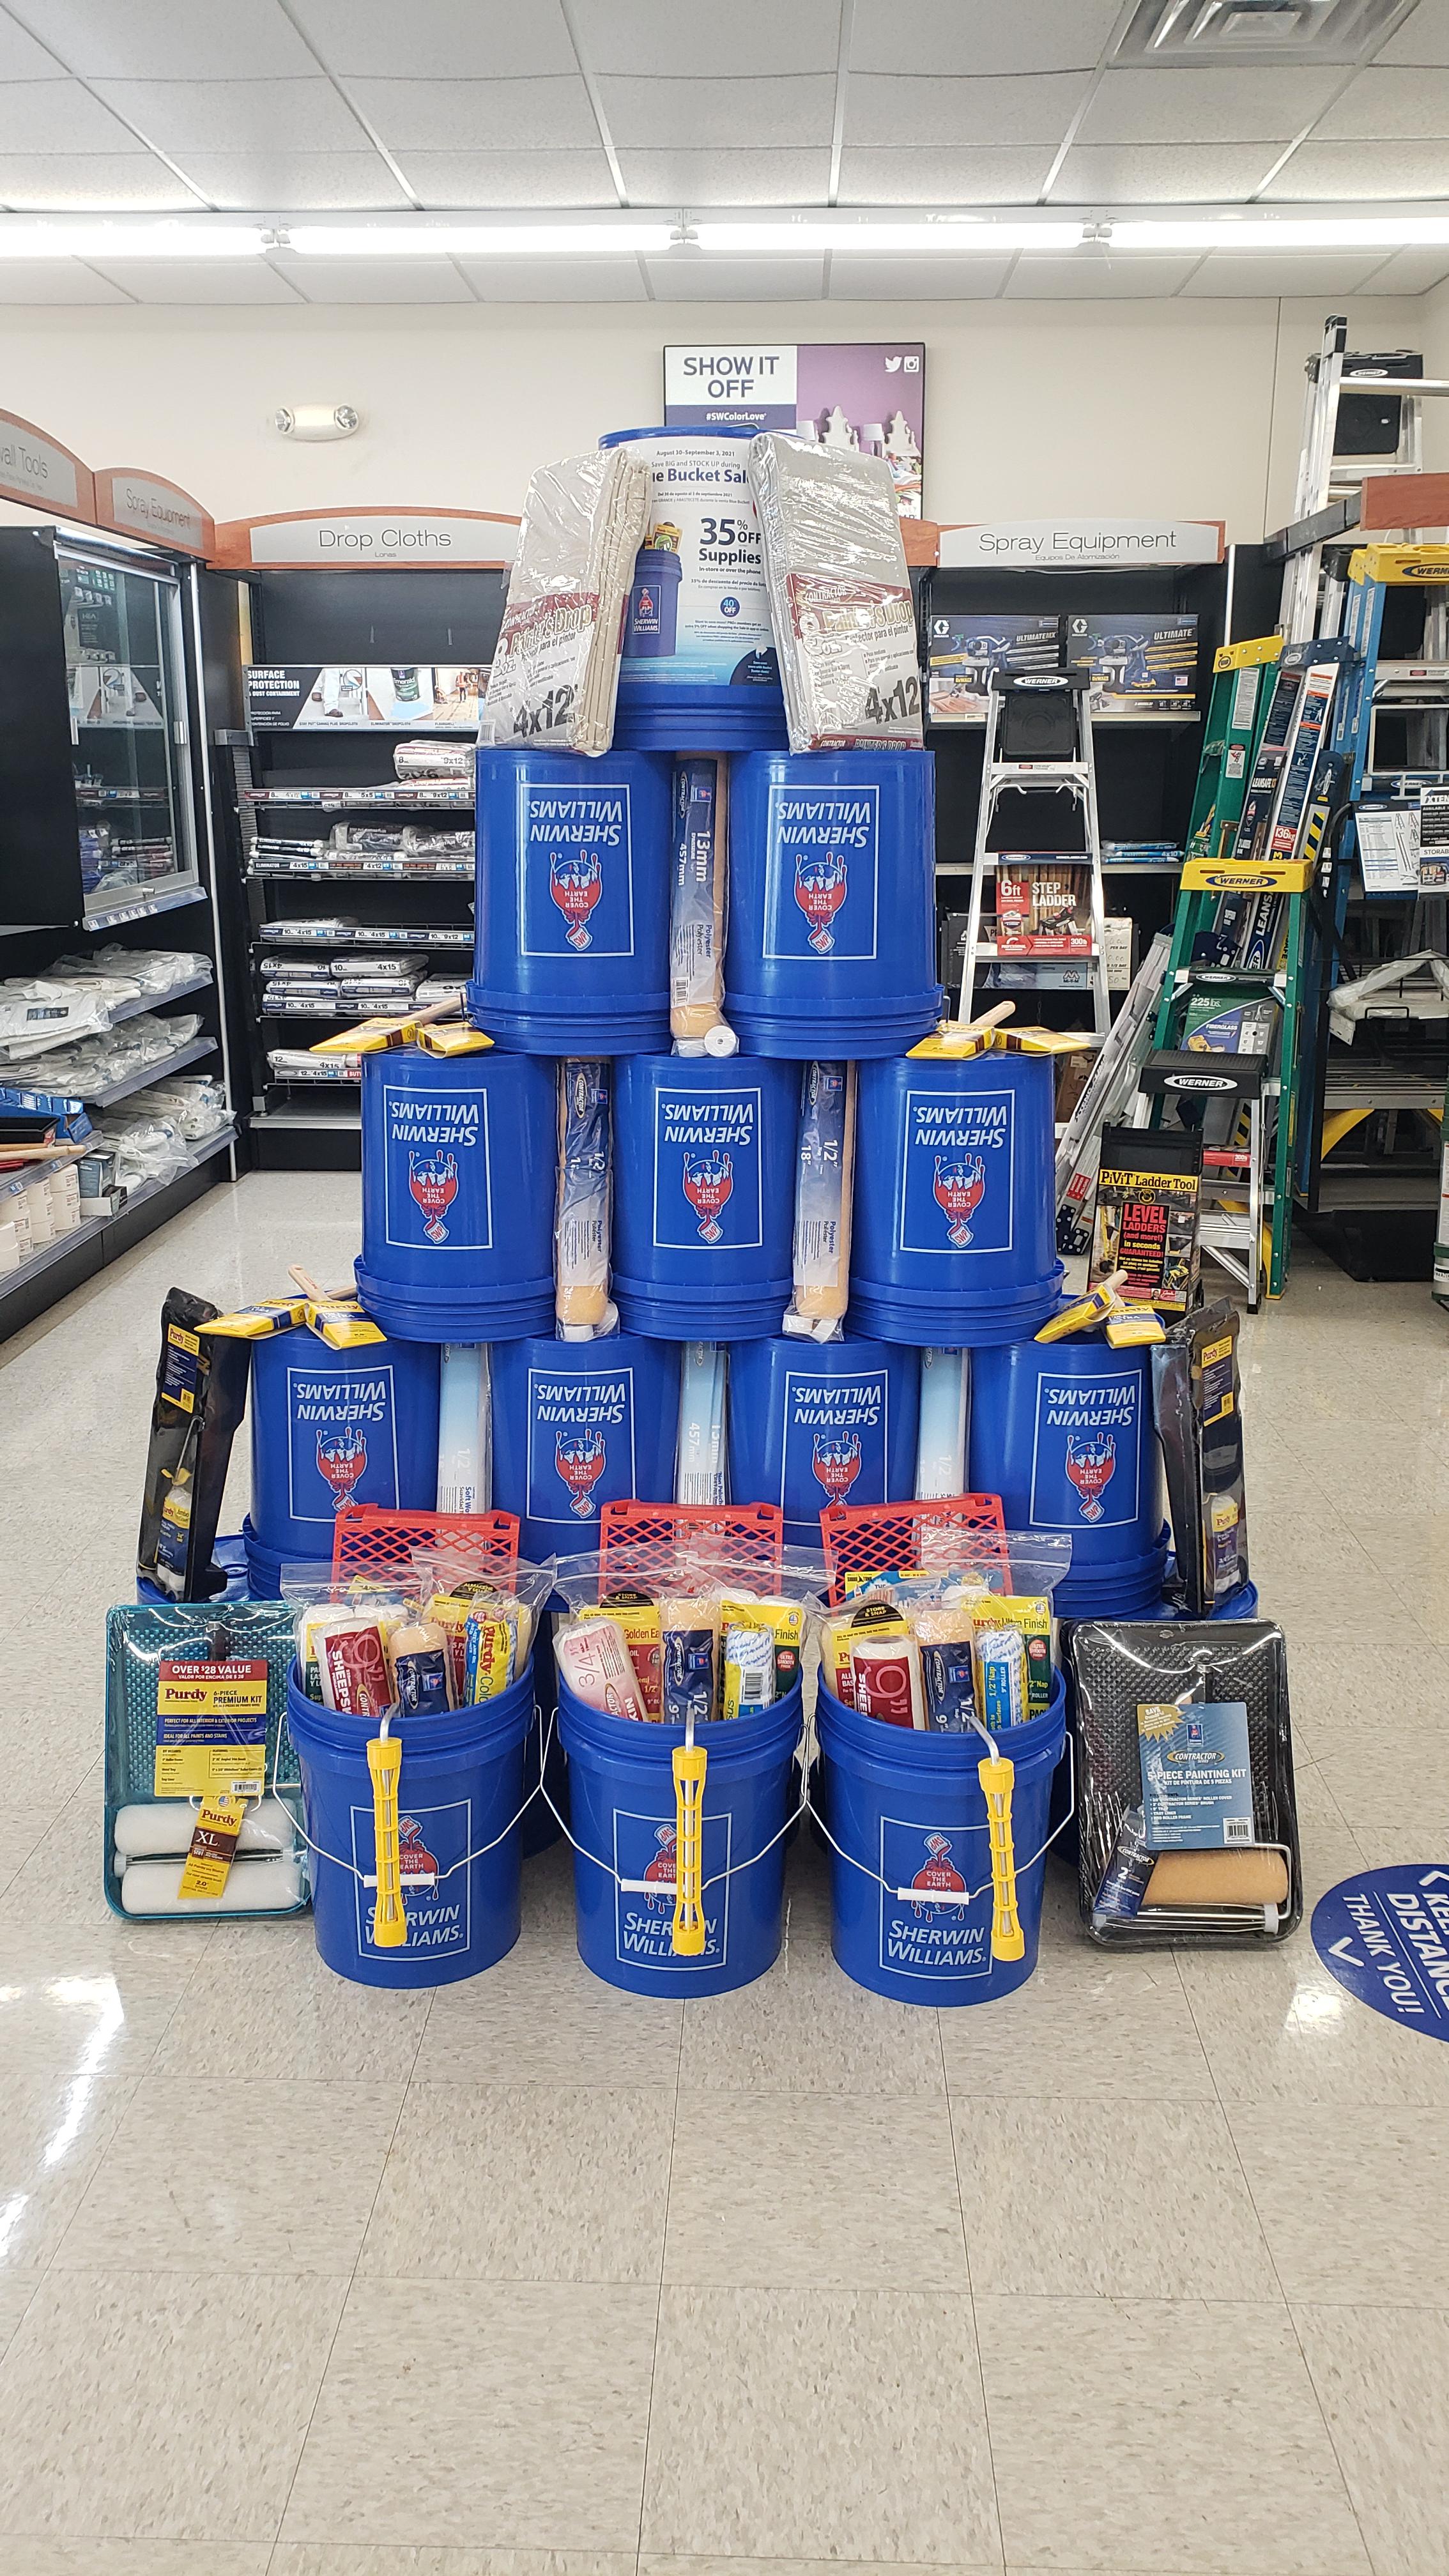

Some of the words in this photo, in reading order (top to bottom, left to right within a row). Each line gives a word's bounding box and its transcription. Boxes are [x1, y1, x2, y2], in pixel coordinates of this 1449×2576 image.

[683, 356, 754, 376] SHOW
[759, 356, 779, 375] IT
[707, 379, 754, 398] OFF
[18, 447, 49, 479] Tools
[721, 461, 740, 470] during
[668, 467, 721, 483] Bucket
[724, 469, 749, 484] Sal
[126, 487, 150, 519] Spray
[151, 497, 192, 530] Equipment
[319, 530, 373, 551] Drop
[381, 529, 451, 547] Cloths
[700, 518, 735, 546] 35
[737, 532, 761, 544] OFF
[979, 533, 1045, 554] Spray
[1053, 530, 1177, 552] Equipment
[699, 548, 762, 565] Supplies
[875, 628, 887, 641] para
[894, 625, 909, 638] pintor
[1016, 632, 1056, 641] ULTIMATEMX
[1154, 628, 1193, 640] ULTIMATE
[248, 670, 285, 679] SURFACE
[248, 680, 300, 689] PROTECTION
[530, 801, 622, 822] WILLIAMS
[776, 802, 871, 824] WILLIAMS
[530, 824, 622, 846] SHERWIN
[776, 826, 870, 848] SHERWIN
[678, 843, 687, 886] 457mm
[696, 831, 710, 882] 13mm
[1000, 879, 1022, 896] 6ft
[1032, 882, 1061, 894] STEP
[1220, 875, 1265, 885] WERNER
[1032, 894, 1077, 907] LADDER
[572, 931, 588, 947] SWP
[815, 935, 829, 949] SWP
[1179, 1078, 1225, 1087] WERNER
[391, 1101, 479, 1124] WILLIAMS
[664, 1103, 754, 1124] WILLIAMS
[915, 1106, 1008, 1127] WILLIAMS
[392, 1123, 479, 1146] SHERWIN
[664, 1126, 753, 1146] SHERWIN
[914, 1128, 1006, 1148] SHERWIN
[1101, 1172, 1134, 1186] PiViT
[1135, 1174, 1173, 1189] Ladder
[1173, 1178, 1197, 1191] Tool
[1123, 1204, 1167, 1224] LEVEL
[1123, 1222, 1167, 1234] LADDERS
[1119, 1248, 1163, 1257] GUARANTEED!
[1132, 1241, 1161, 1250] seconds
[170, 1328, 184, 1344] Purdy
[1203, 1348, 1217, 1361] Purdy
[297, 1381, 387, 1401] WILLIAMS
[537, 1384, 626, 1403] WILLIAMS
[795, 1386, 881, 1405] WILLIAMS
[1047, 1385, 1136, 1406] WILLIAMS
[297, 1402, 386, 1422] SHERWIN
[537, 1405, 625, 1424] SHERWIN
[794, 1406, 880, 1425] SHERWIN
[1046, 1406, 1135, 1426] SHERWIN
[1024, 1618, 1048, 1629] Finish
[624, 1629, 649, 1639] Golden
[775, 1629, 799, 1640] Finish
[172, 1665, 199, 1674] OVER
[201, 1665, 217, 1674] $28
[218, 1664, 252, 1674] VALUE
[935, 1658, 944, 1696] CONTRACTOR
[407, 1667, 417, 1702] CONTRACTOR
[1037, 1680, 1048, 1689] Nap
[165, 1688, 208, 1701] Purdy
[213, 1696, 249, 1704] PREMIUM
[250, 1695, 263, 1703] KIT
[1145, 1706, 1161, 1715] SAVE
[1174, 1752, 1217, 1761] CONTRACTOR
[1147, 1770, 1183, 1781] 5-PIECE
[1186, 1769, 1230, 1779] PAINTING
[1232, 1768, 1247, 1778] KIT
[201, 1809, 238, 1827] Purdy
[195, 1830, 218, 1846] XL
[1122, 1848, 1150, 1863] CONTRACTOR
[889, 1919, 985, 1945] SHERWIN
[887, 1938, 986, 1966] WILLIAMS
[1342, 1894, 1396, 1957] THANK
[1376, 1962, 1425, 2014] YOU!
